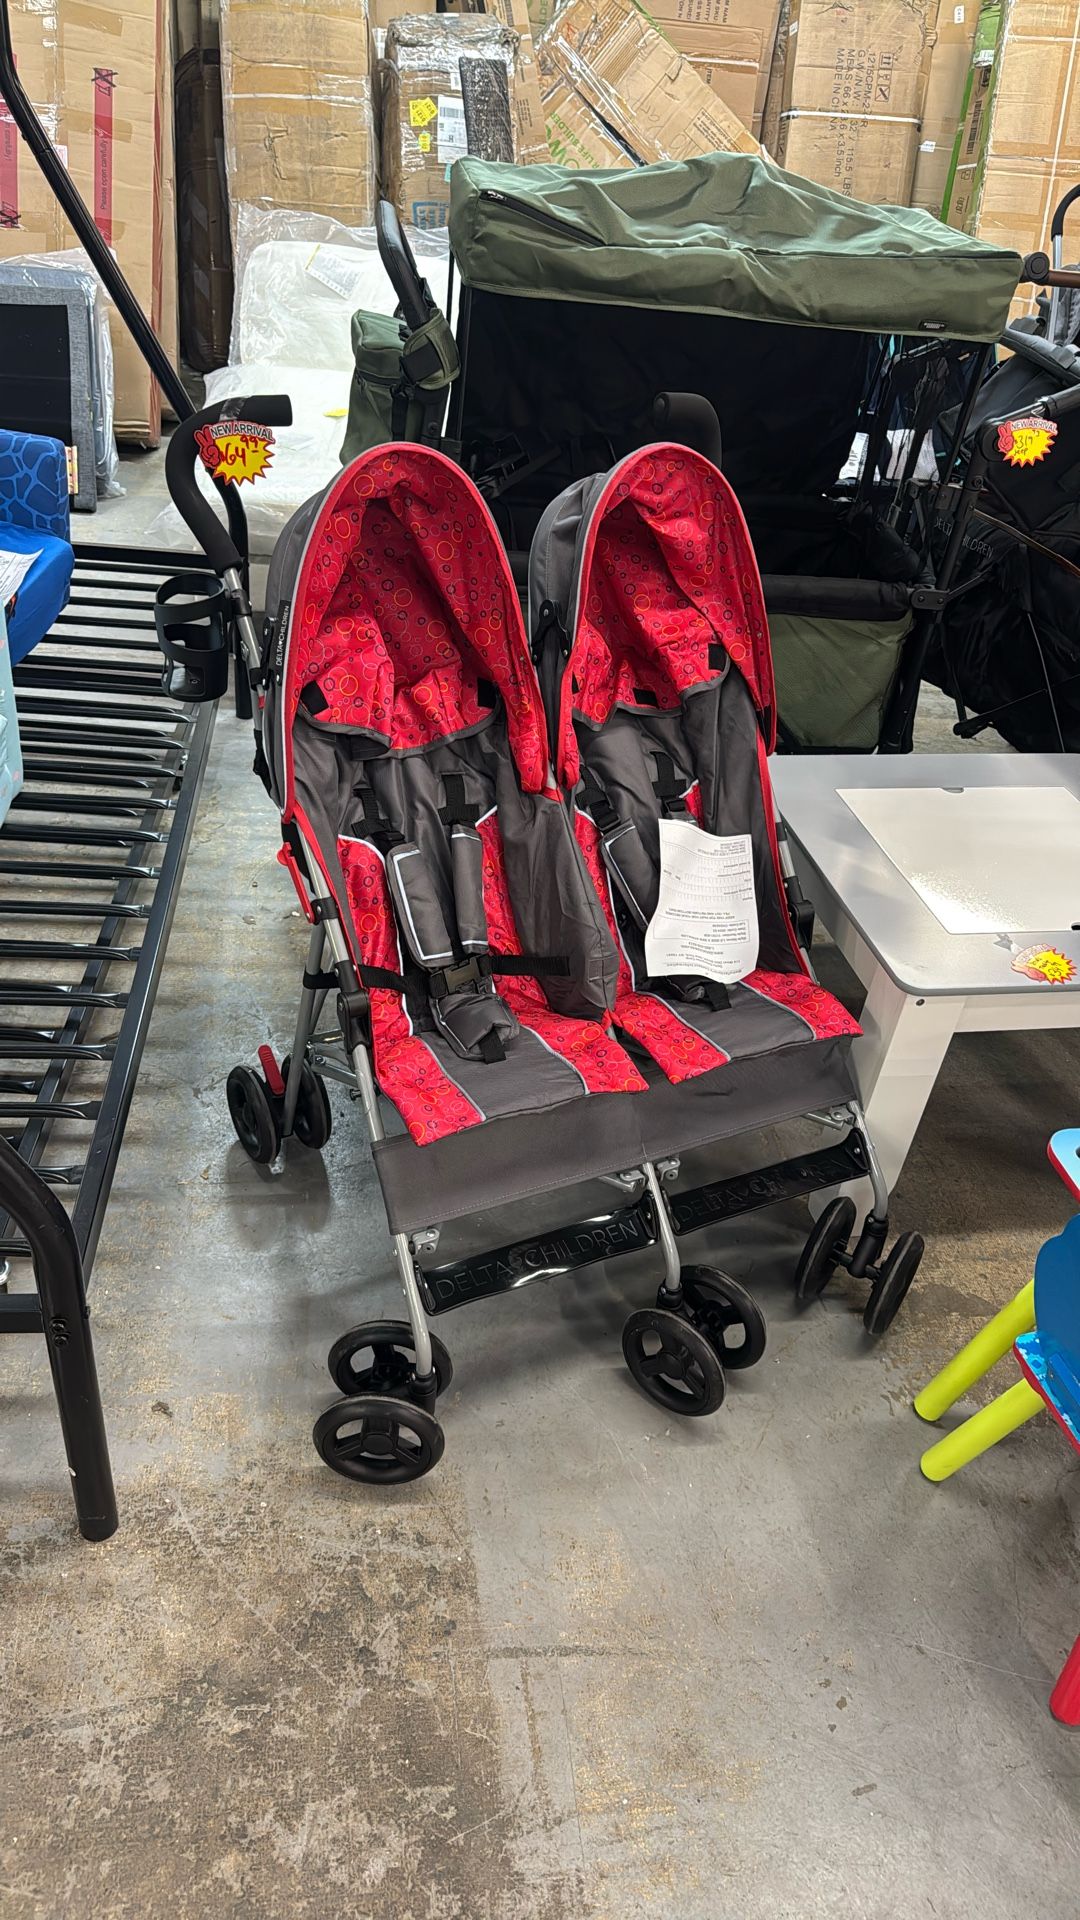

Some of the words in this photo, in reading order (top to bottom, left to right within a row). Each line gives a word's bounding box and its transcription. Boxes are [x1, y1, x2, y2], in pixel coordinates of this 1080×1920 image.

[835, 48, 846, 80] MADE
[211, 424, 232, 438] NEW
[234, 424, 273, 440] ARRIVAL
[1012, 422, 1028, 430] NEW
[1028, 420, 1057, 432] ARRIVAL
[278, 605, 290, 641] CHILDREN
[276, 645, 284, 667] DELTA
[434, 1260, 513, 1300] DELTA
[523, 1218, 639, 1269] CHILDREN
